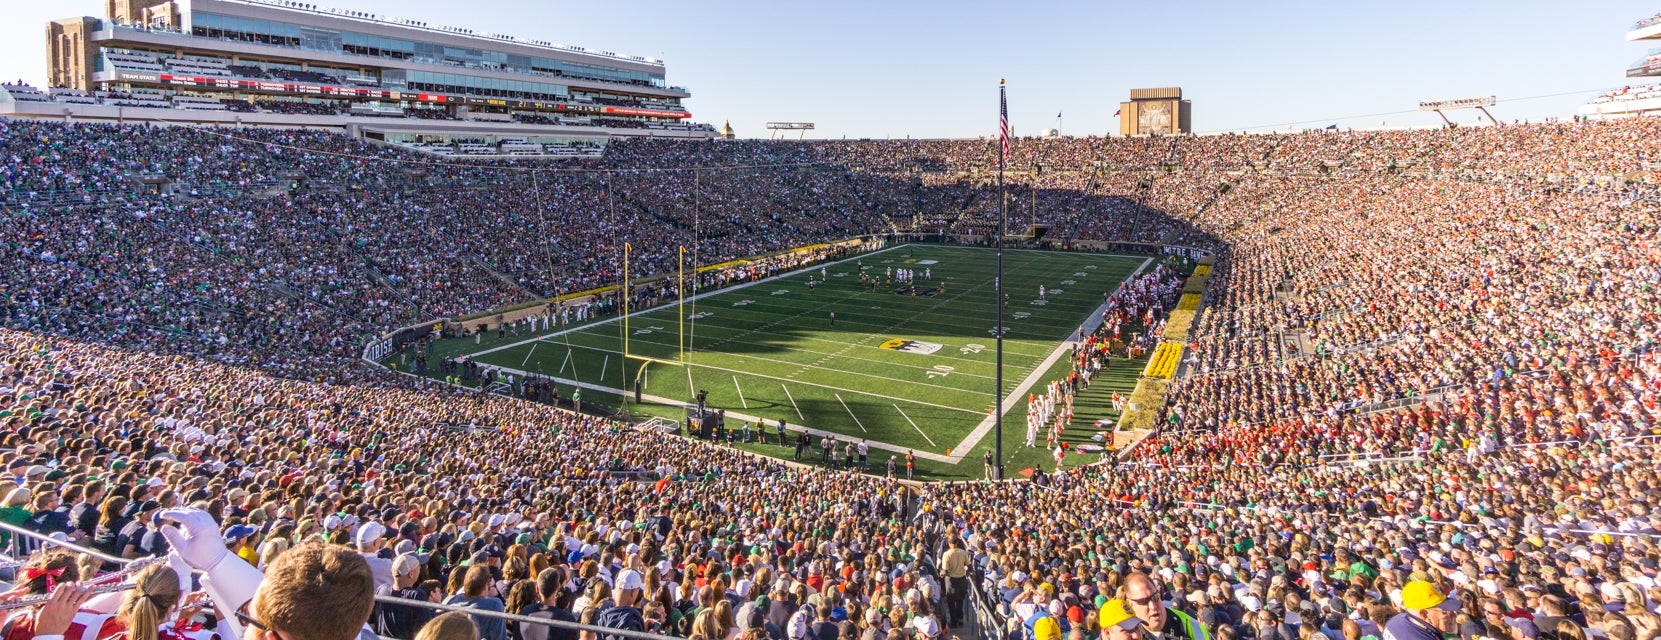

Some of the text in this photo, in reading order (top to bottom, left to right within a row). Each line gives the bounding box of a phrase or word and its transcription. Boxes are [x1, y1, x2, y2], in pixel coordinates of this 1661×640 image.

[1163, 246, 1186, 256] NOTRE
[372, 338, 393, 360] IRISH
[960, 343, 986, 355] 20
[926, 365, 955, 378] 10
